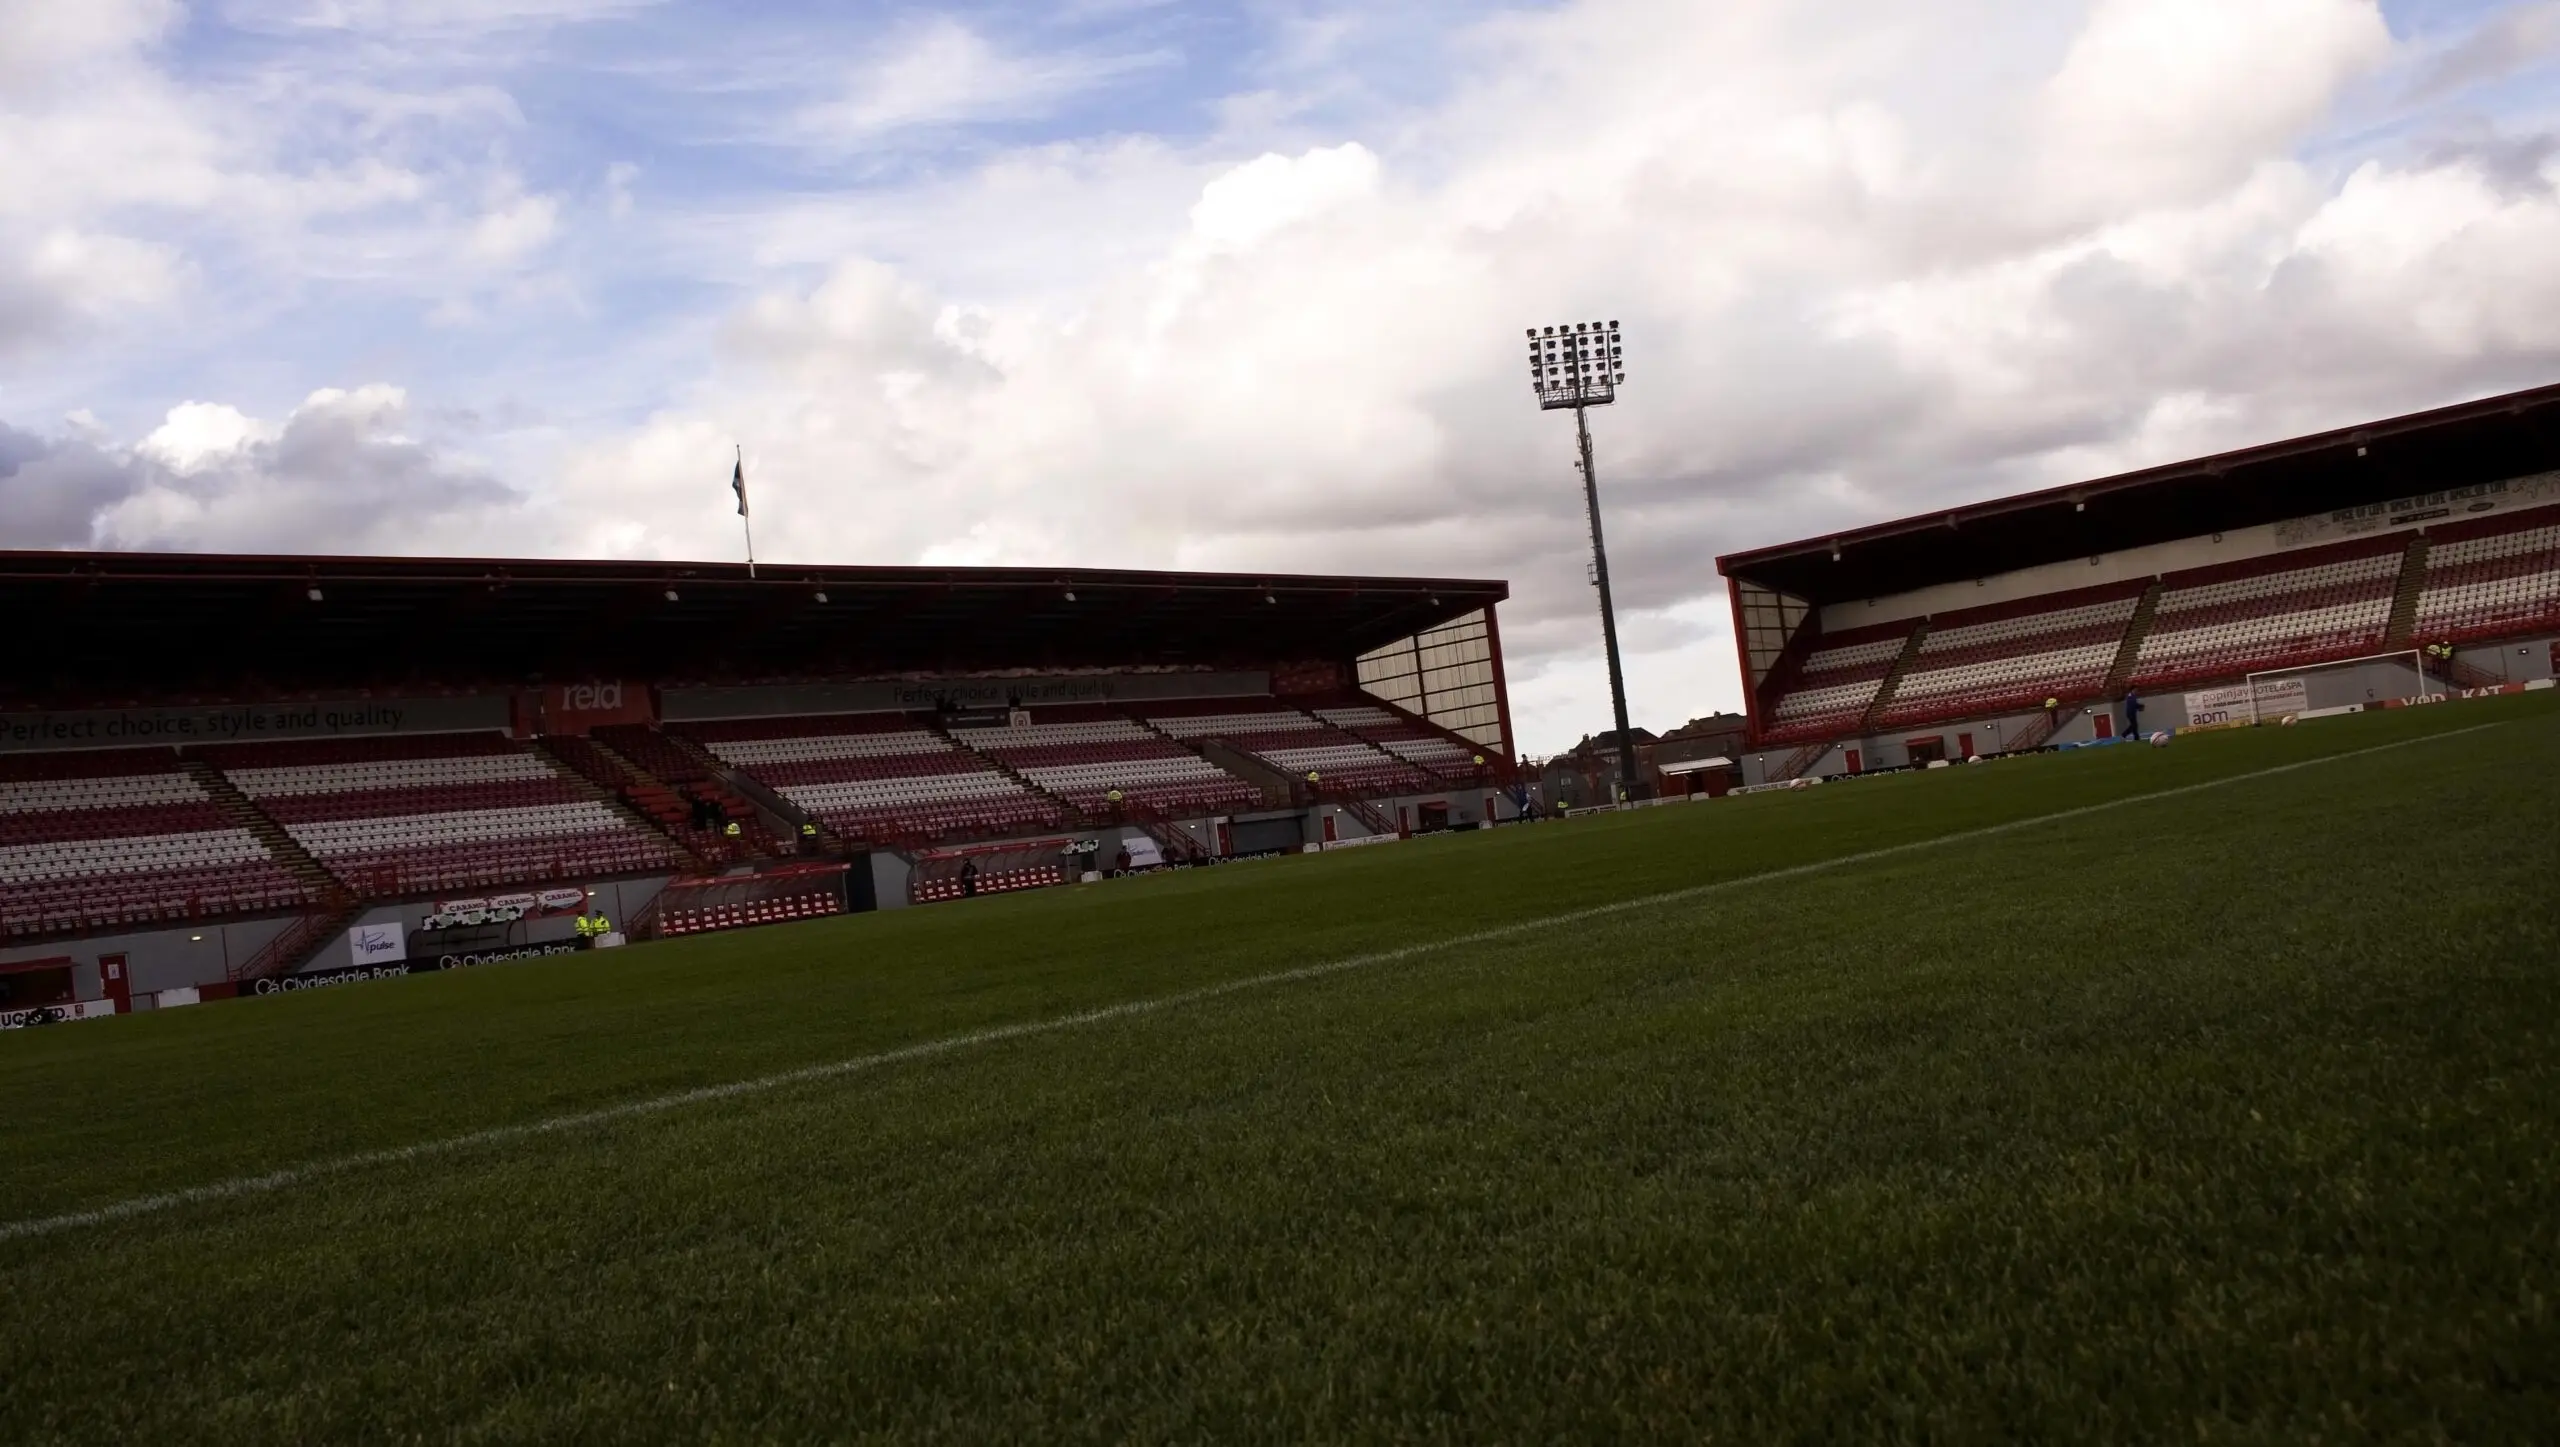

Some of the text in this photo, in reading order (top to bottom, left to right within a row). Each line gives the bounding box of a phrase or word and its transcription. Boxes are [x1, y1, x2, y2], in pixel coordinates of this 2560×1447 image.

[562, 679, 623, 711] reid
[0, 713, 95, 741] Perfect
[107, 713, 199, 737] choice,
[208, 708, 266, 737] style
[276, 706, 317, 729] and
[282, 964, 410, 993] Clydesdale Bank
